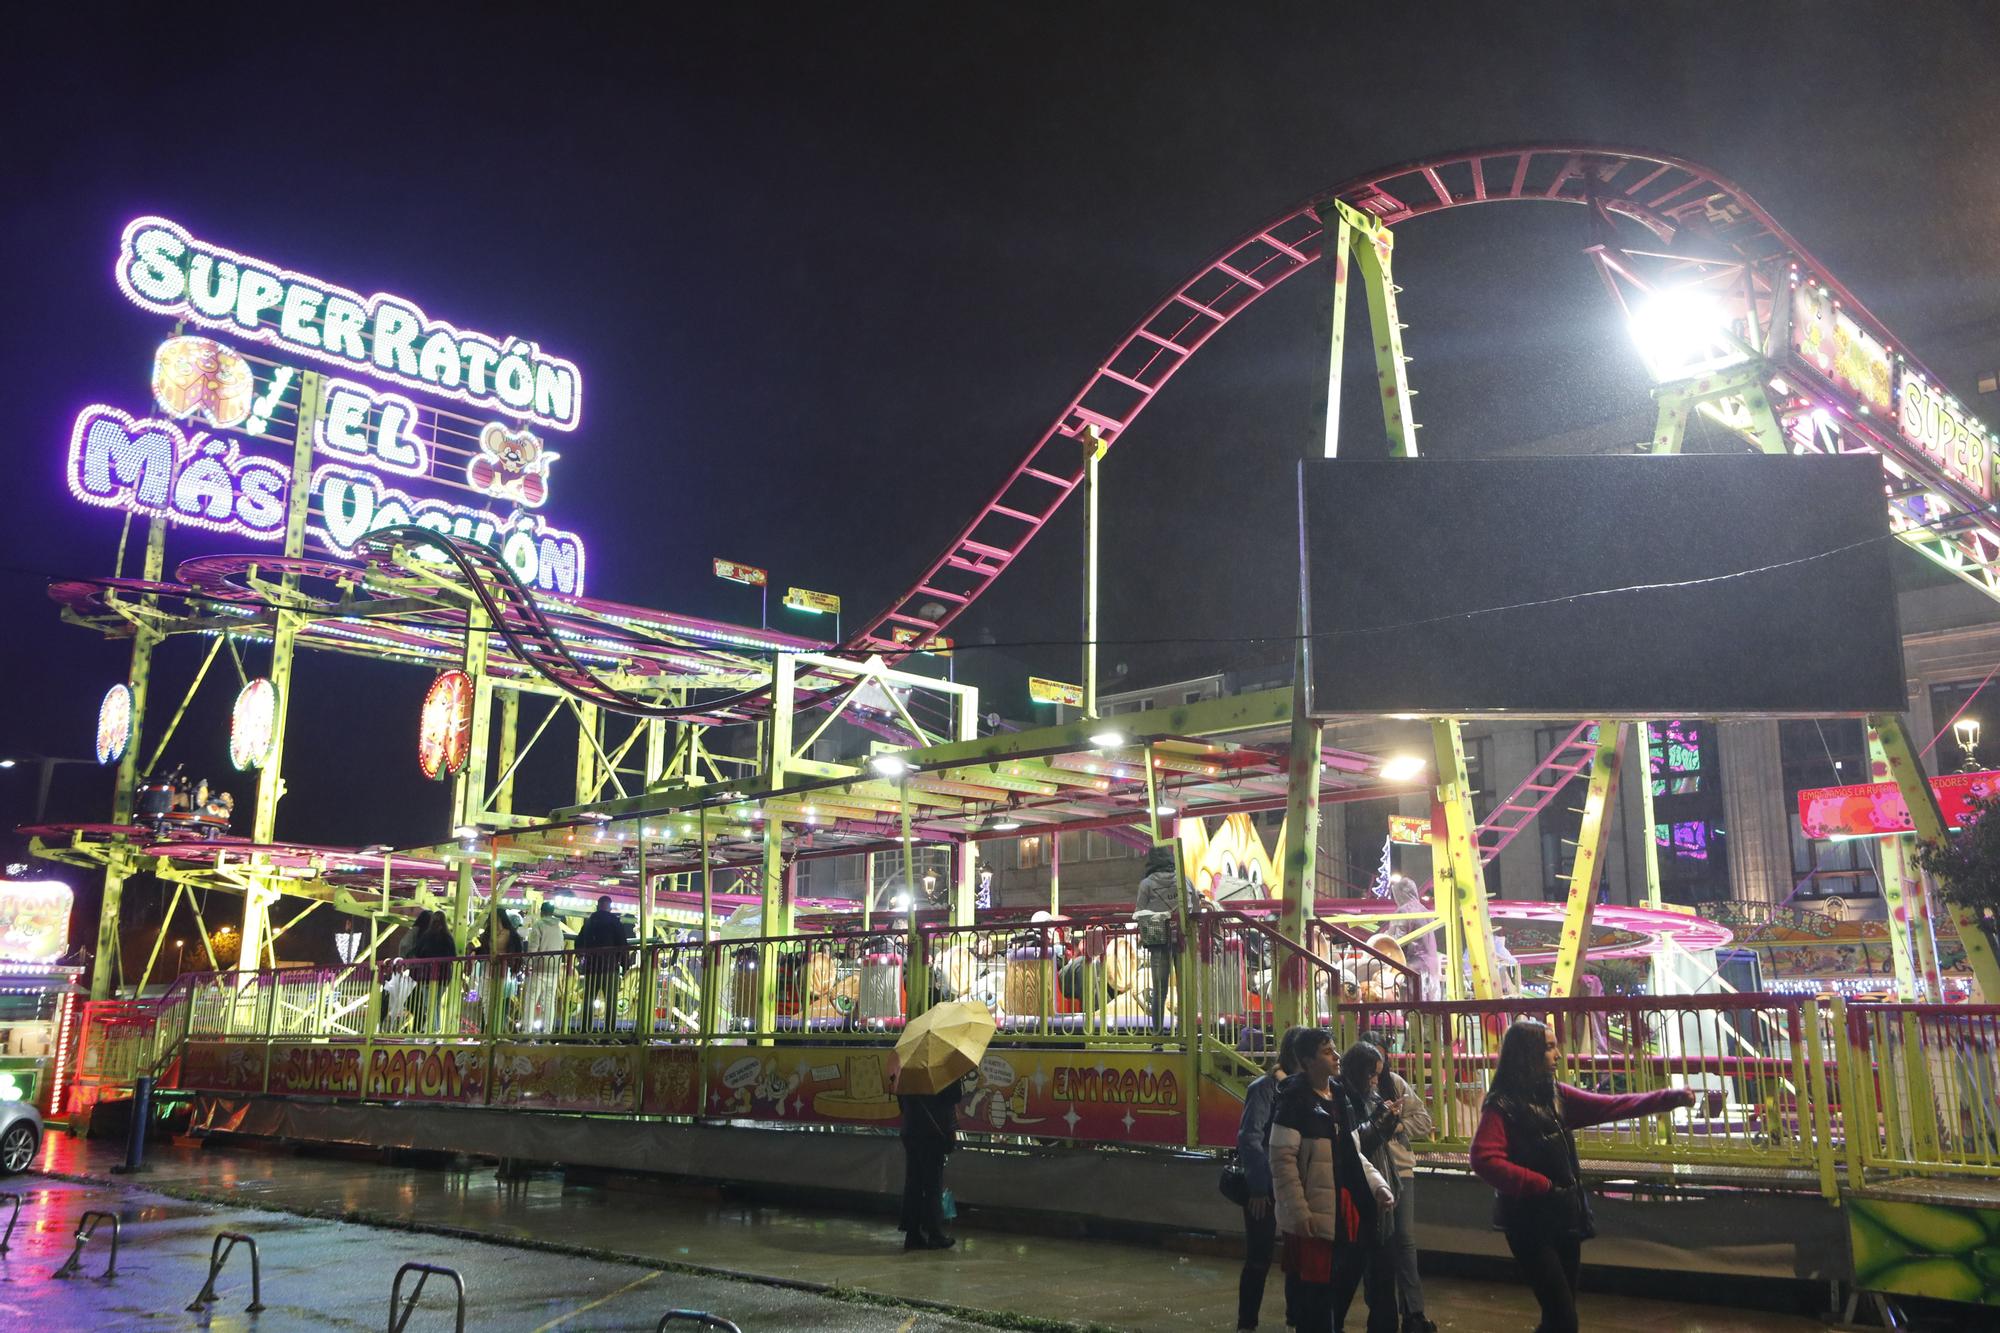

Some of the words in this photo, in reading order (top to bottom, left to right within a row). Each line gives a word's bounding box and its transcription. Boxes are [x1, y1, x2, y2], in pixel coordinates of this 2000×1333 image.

[327, 391, 415, 465] EL
[1904, 382, 1984, 489] SUPER
[83, 418, 284, 528] MÁS
[287, 1047, 361, 1092] SUPER
[368, 1045, 464, 1098] RATÓN
[1053, 1066, 1178, 1105] ENTRADA
